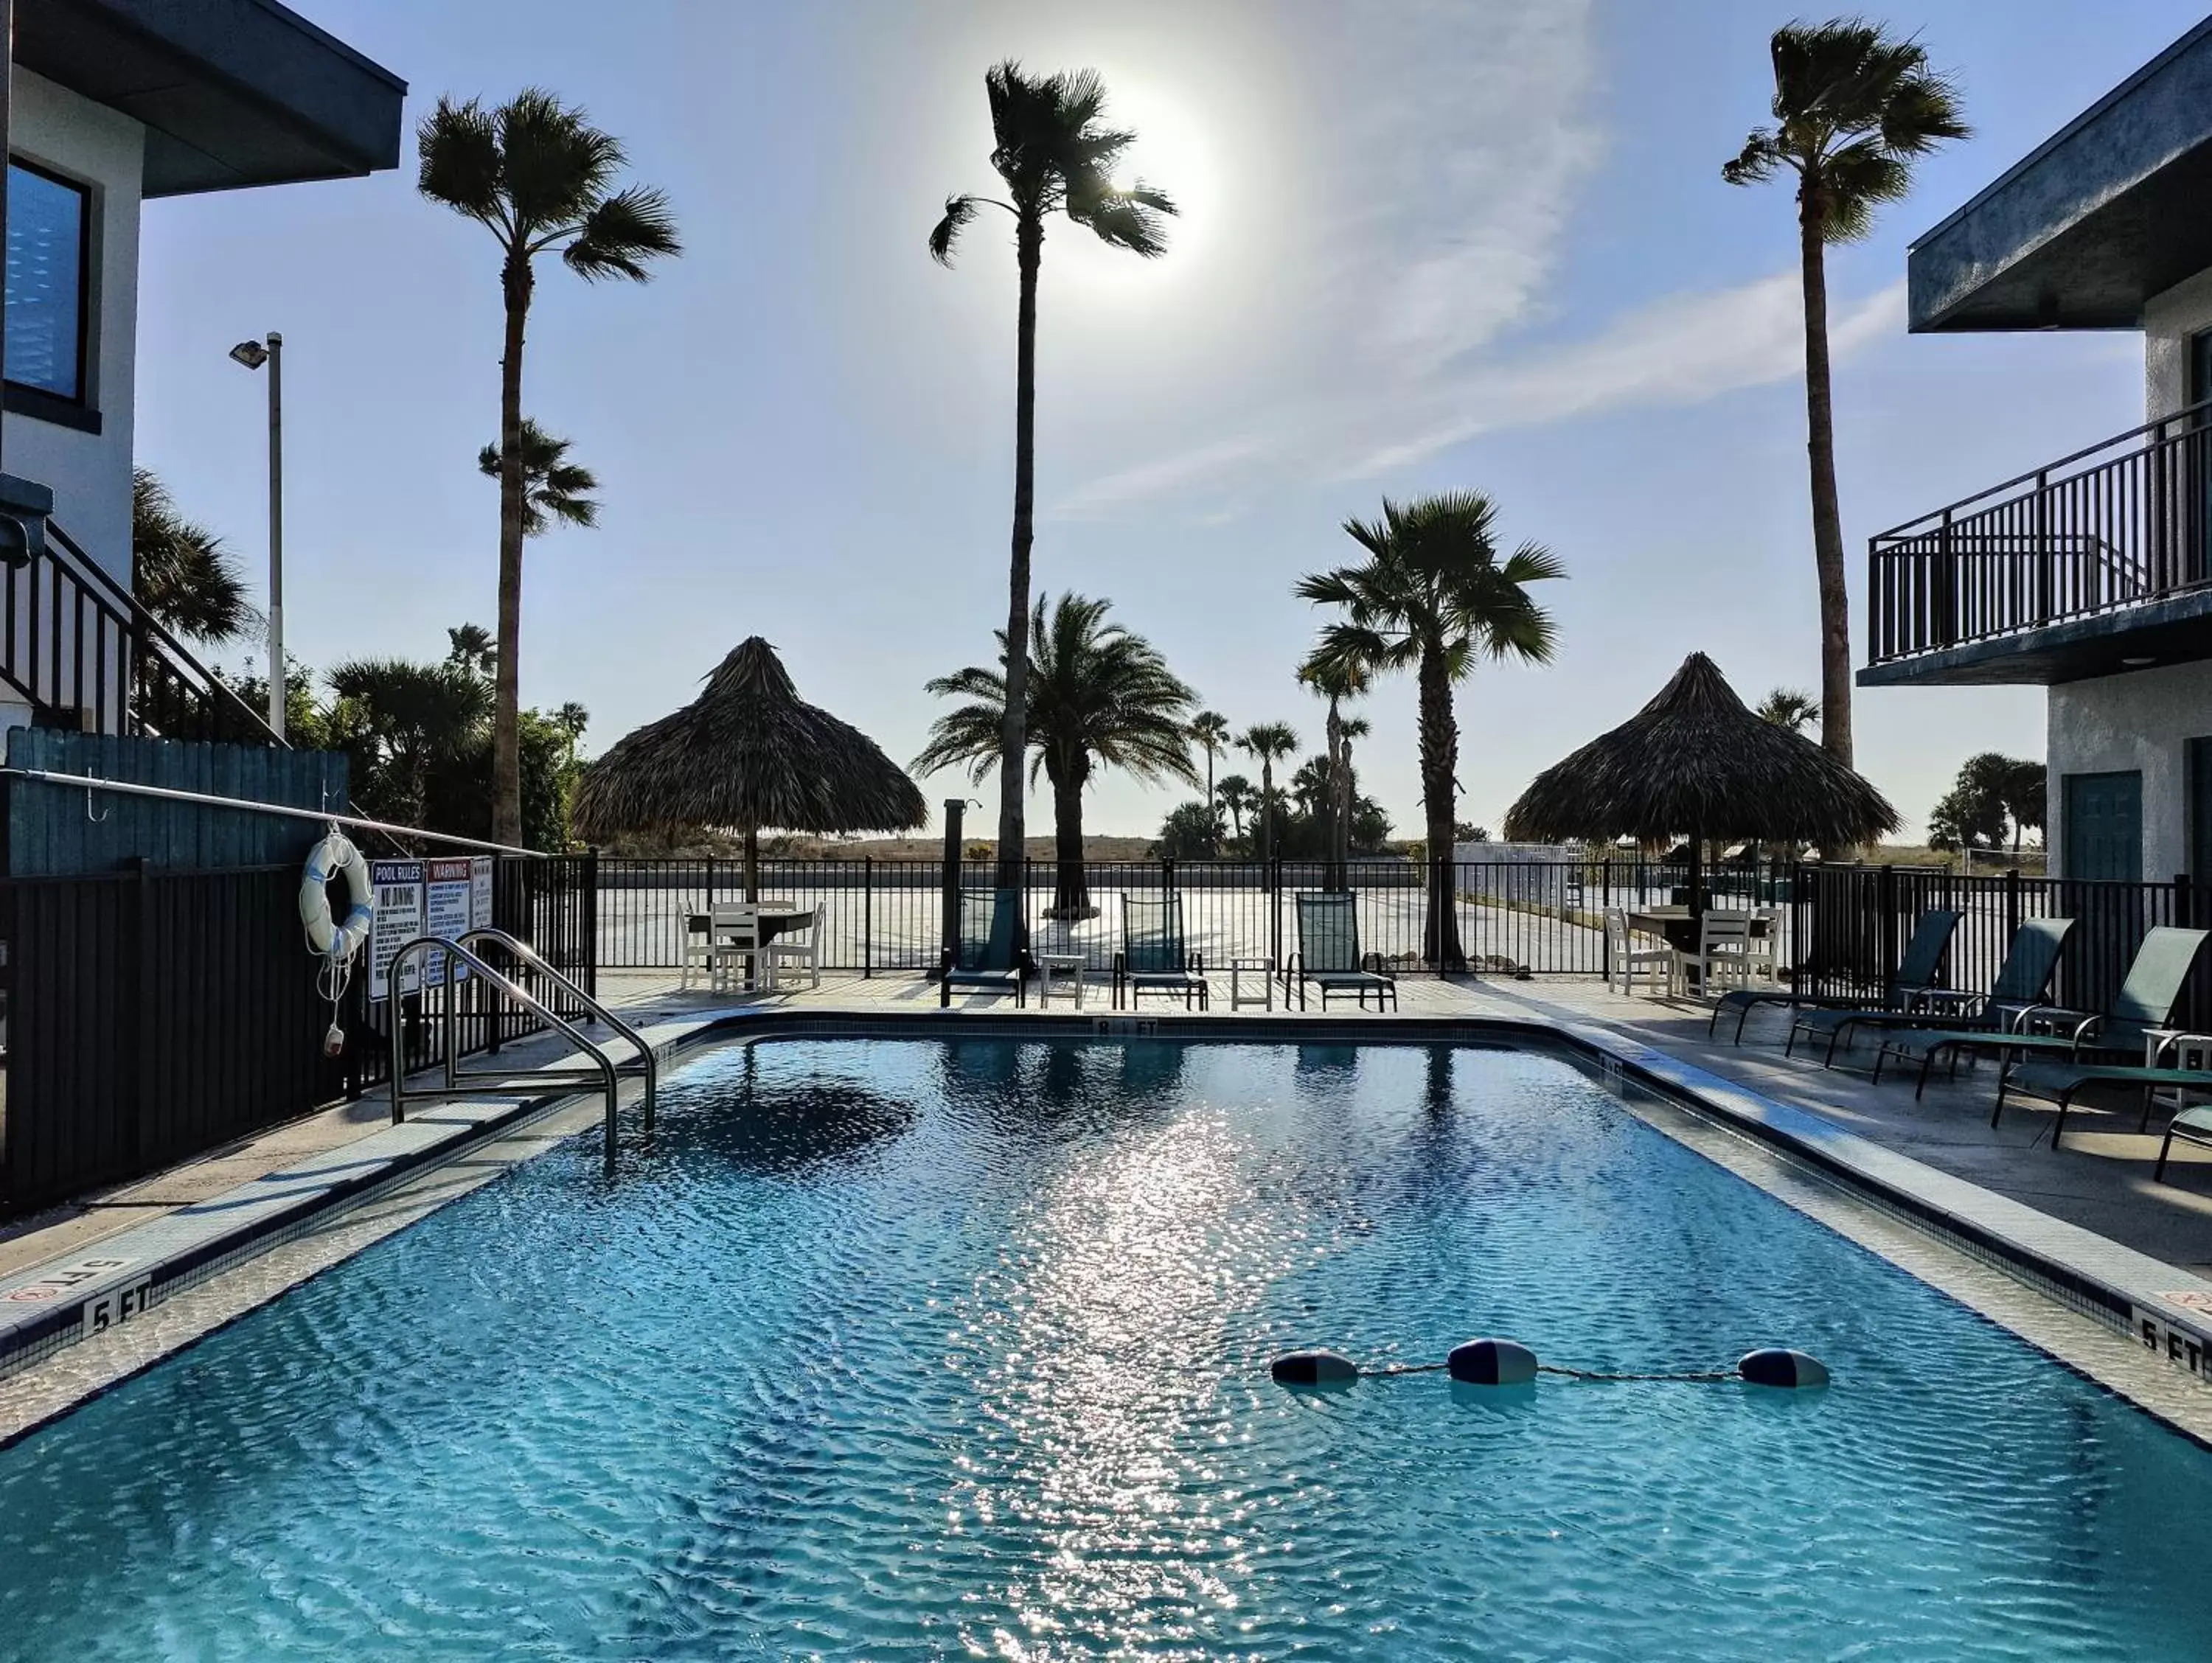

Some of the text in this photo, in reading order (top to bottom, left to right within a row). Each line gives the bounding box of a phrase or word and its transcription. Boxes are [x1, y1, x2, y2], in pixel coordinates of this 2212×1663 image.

[375, 866, 420, 881] POOL RULES
[433, 863, 467, 879] WARNING
[380, 887, 390, 907] NO
[94, 1281, 150, 1333] 5 FT
[2142, 1318, 2202, 1372] 5 FT
